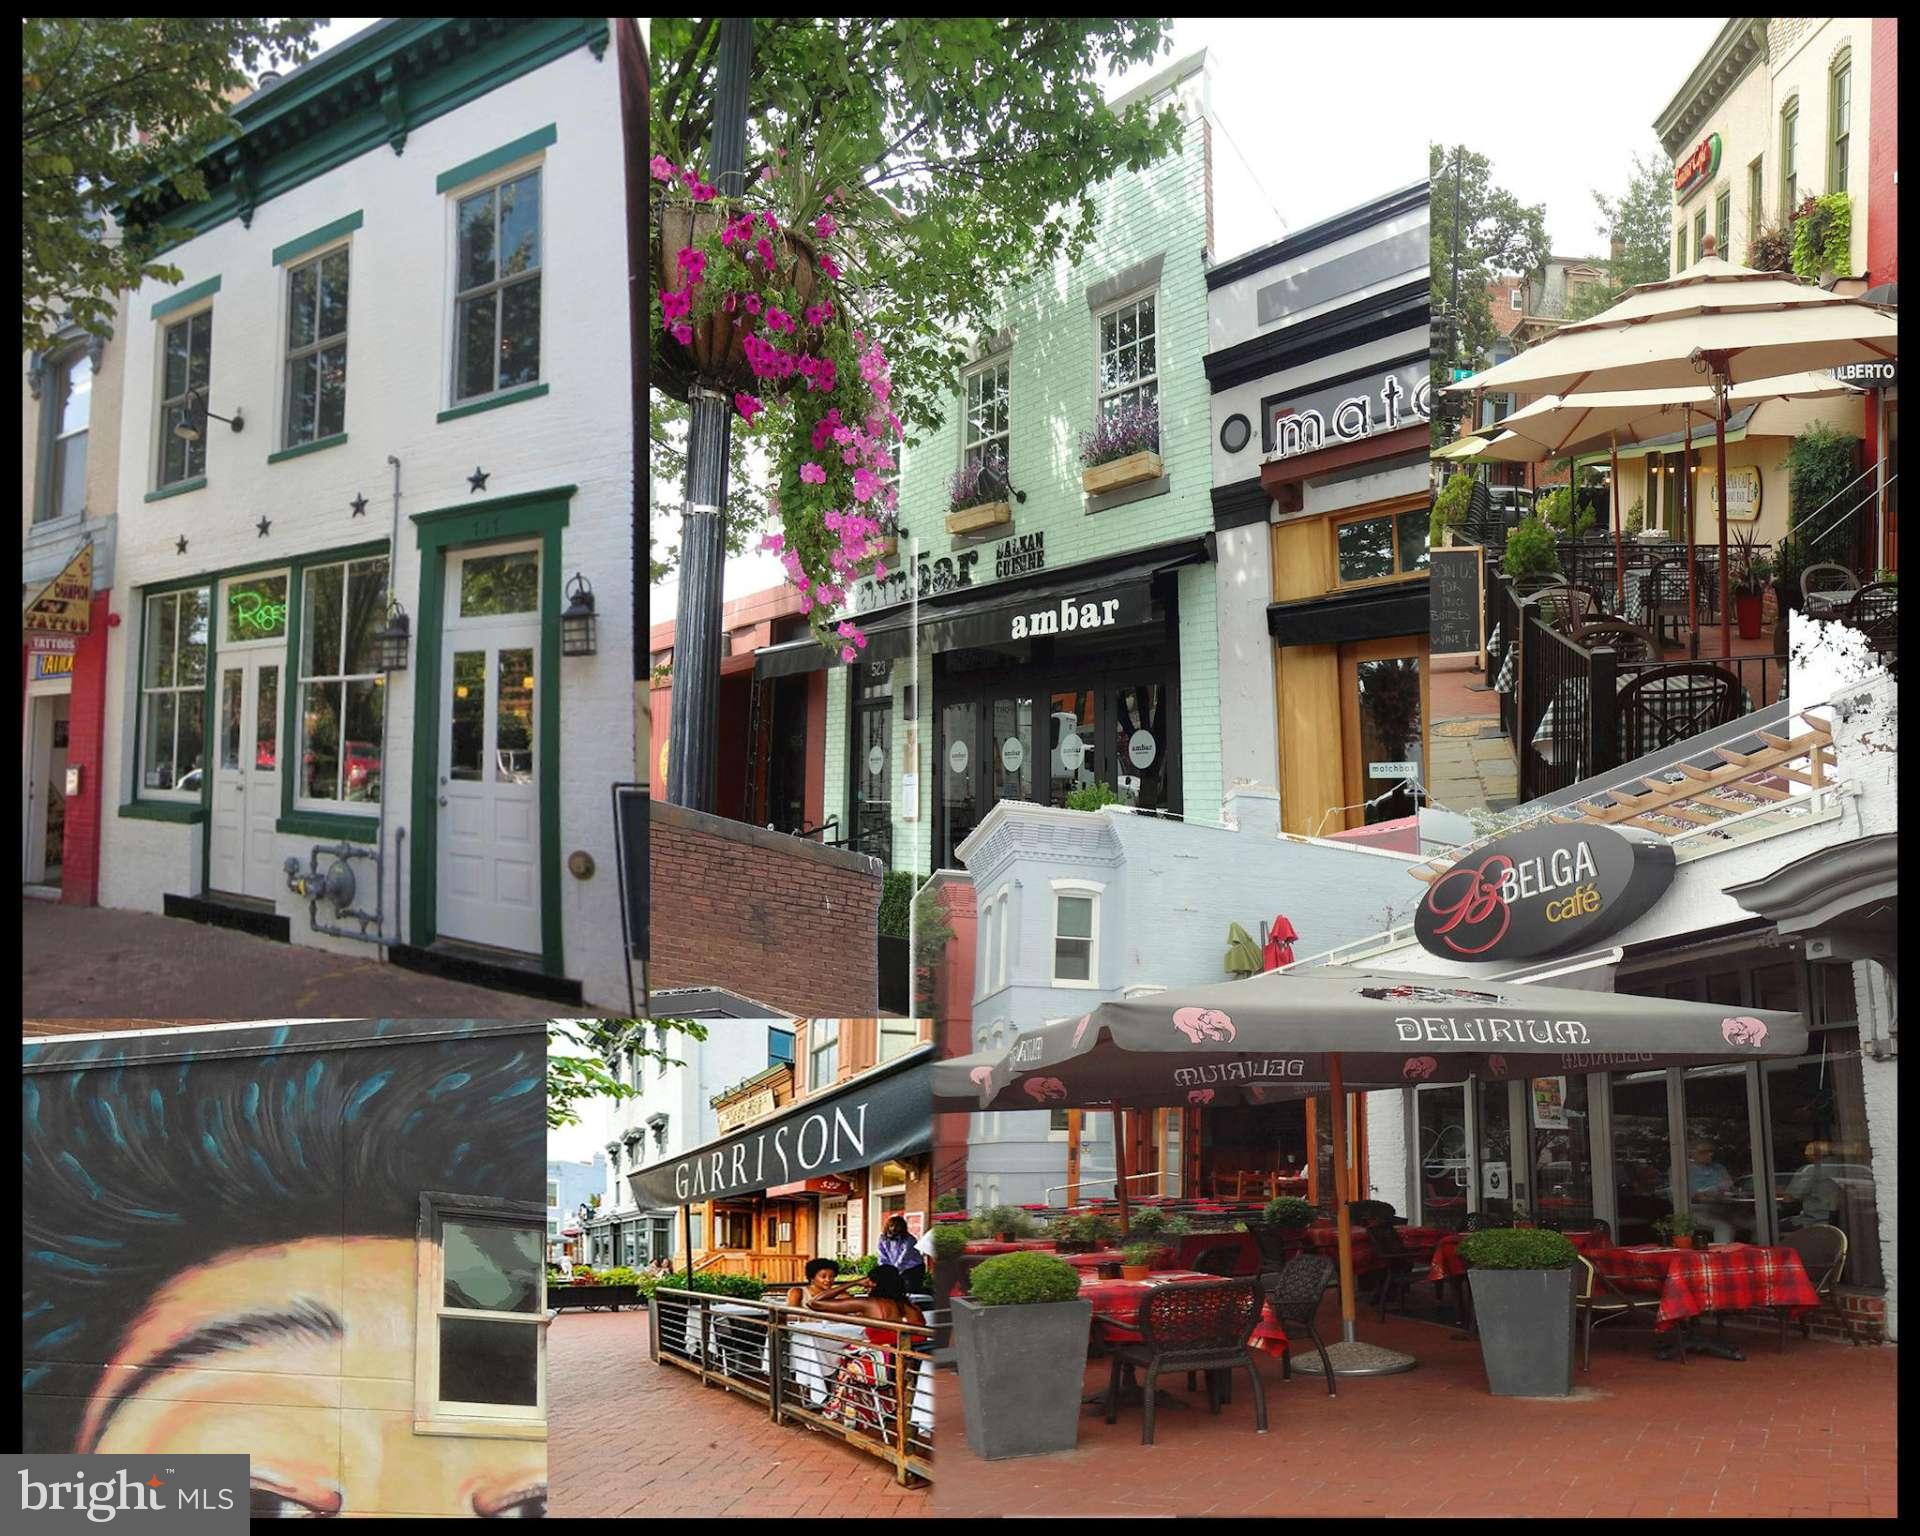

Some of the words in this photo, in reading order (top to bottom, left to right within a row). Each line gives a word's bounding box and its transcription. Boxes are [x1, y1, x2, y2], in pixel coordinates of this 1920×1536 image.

[996, 531, 1045, 560] BALKAN
[996, 551, 1045, 578] CUISINE
[1011, 598, 1120, 640] ambar
[1500, 841, 1600, 904] BELGA
[1546, 883, 1602, 923] café
[1395, 1017, 1591, 1044] DELIRIUM
[675, 1103, 869, 1199] GARRISON
